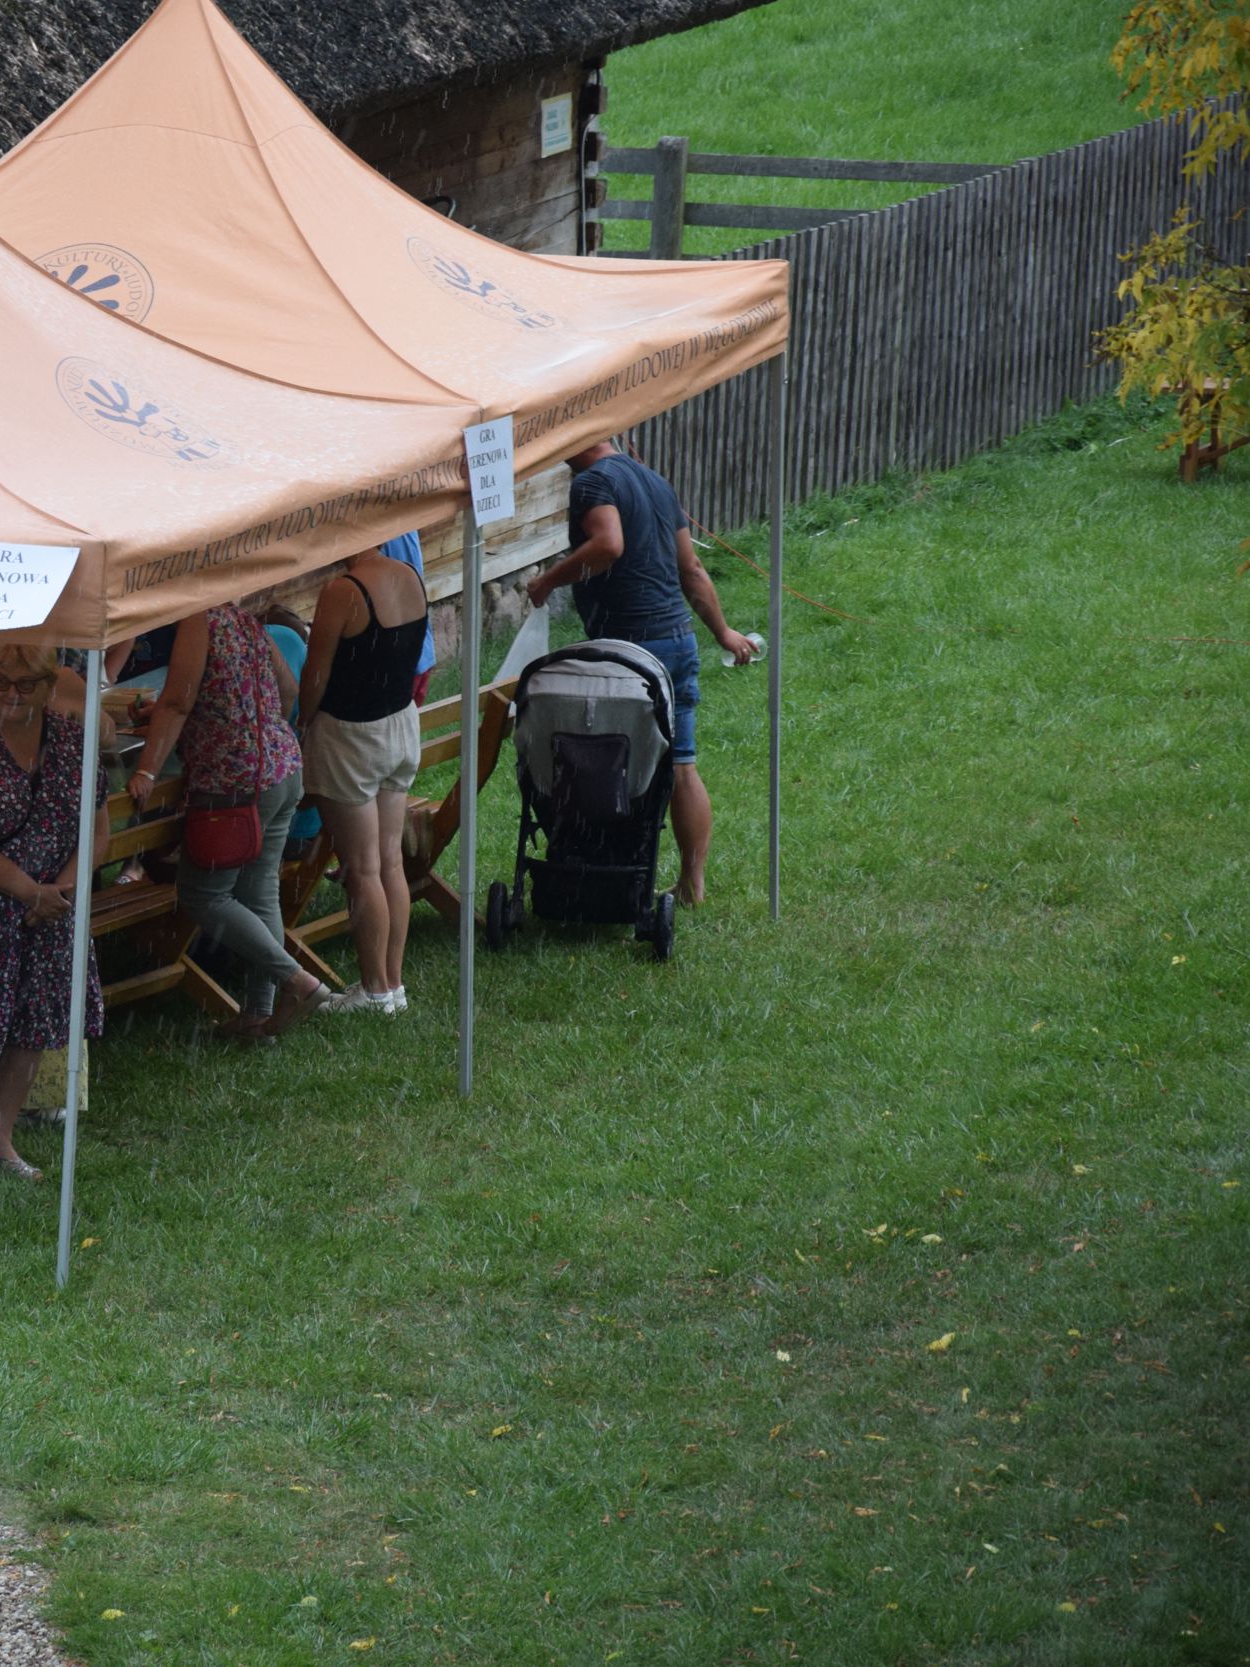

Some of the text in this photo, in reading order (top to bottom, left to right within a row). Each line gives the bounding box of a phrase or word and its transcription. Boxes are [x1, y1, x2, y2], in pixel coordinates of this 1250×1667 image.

[123, 273, 143, 318] LUDO
[625, 341, 686, 392] LUDOWEJ
[479, 428, 496, 444] GRA
[480, 475, 496, 490] DLA
[476, 494, 501, 513] DZIECI
[121, 548, 198, 598] MUZEUM
[199, 519, 278, 569] KULTURY
[276, 492, 355, 541] LUDOWEJ
